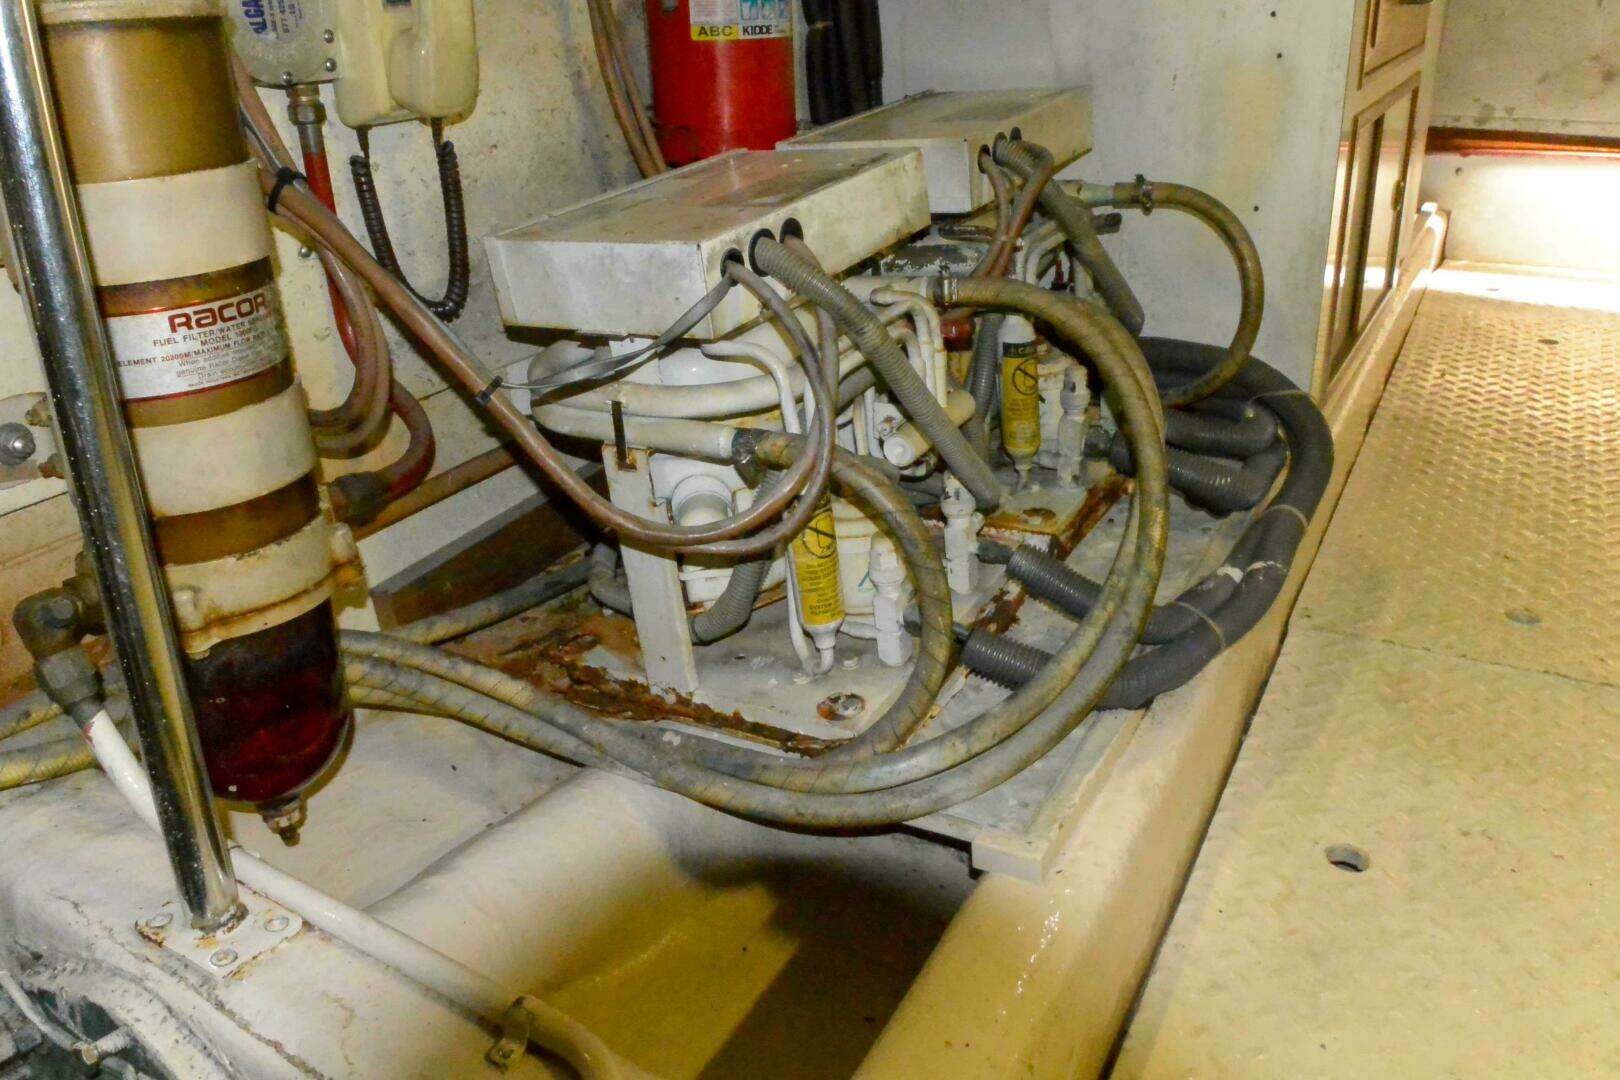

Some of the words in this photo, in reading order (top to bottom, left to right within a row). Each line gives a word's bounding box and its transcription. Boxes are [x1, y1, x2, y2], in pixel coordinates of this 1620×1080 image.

[698, 25, 733, 37] ABC
[742, 24, 773, 36] KIDDE
[153, 337, 179, 347] FUEL
[200, 334, 232, 347] MODEL
[118, 357, 156, 368] ELEMENT
